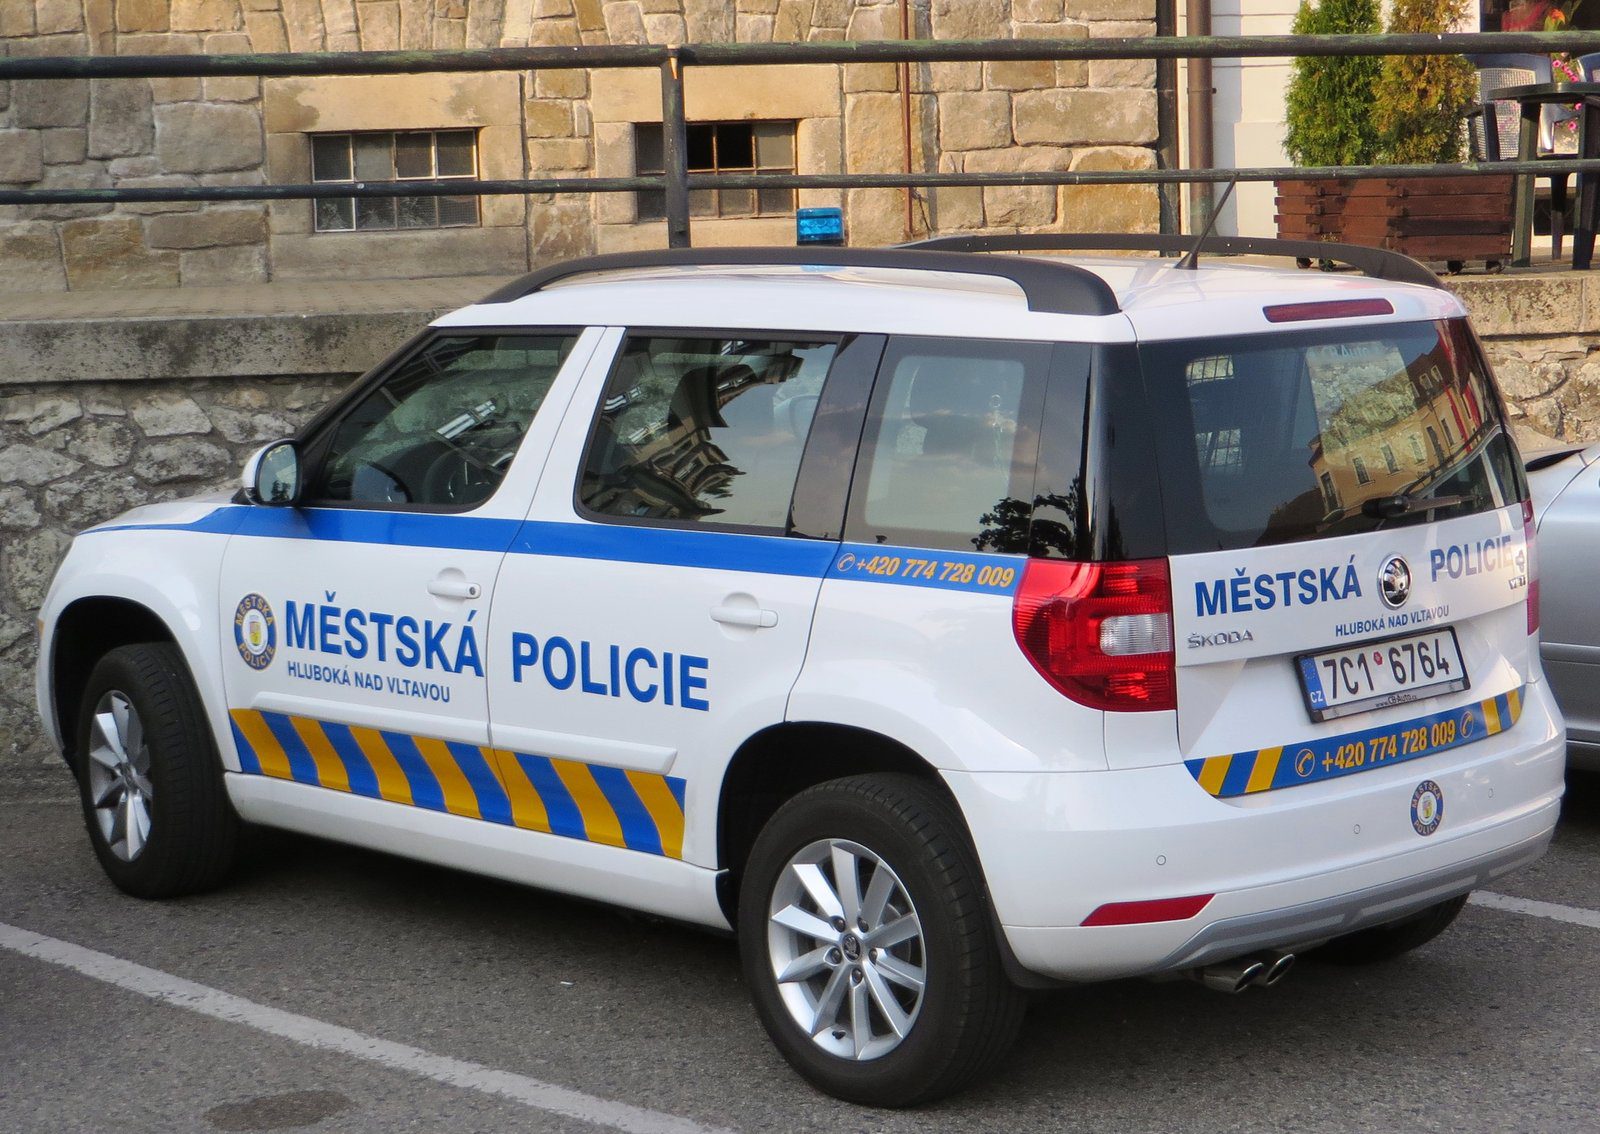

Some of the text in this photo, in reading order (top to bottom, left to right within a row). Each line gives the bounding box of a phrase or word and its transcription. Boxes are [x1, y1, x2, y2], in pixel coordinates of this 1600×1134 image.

[857, 556, 1015, 588] +420 774 728 009
[1195, 534, 1513, 617] MĚSTSKÁ POLICIE
[1187, 630, 1254, 649] ŠKODA
[1335, 604, 1449, 637] HLUBOKÁ NAD VLTAVOU
[286, 590, 710, 711] MĚSTSKÁ POLICIE
[1322, 638, 1450, 700] 7C1 6764
[288, 660, 450, 703] HLUBOKÁ NAD VLTAVOU
[1310, 690, 1323, 704] CZ
[1322, 719, 1456, 772] +420 774 728 009
